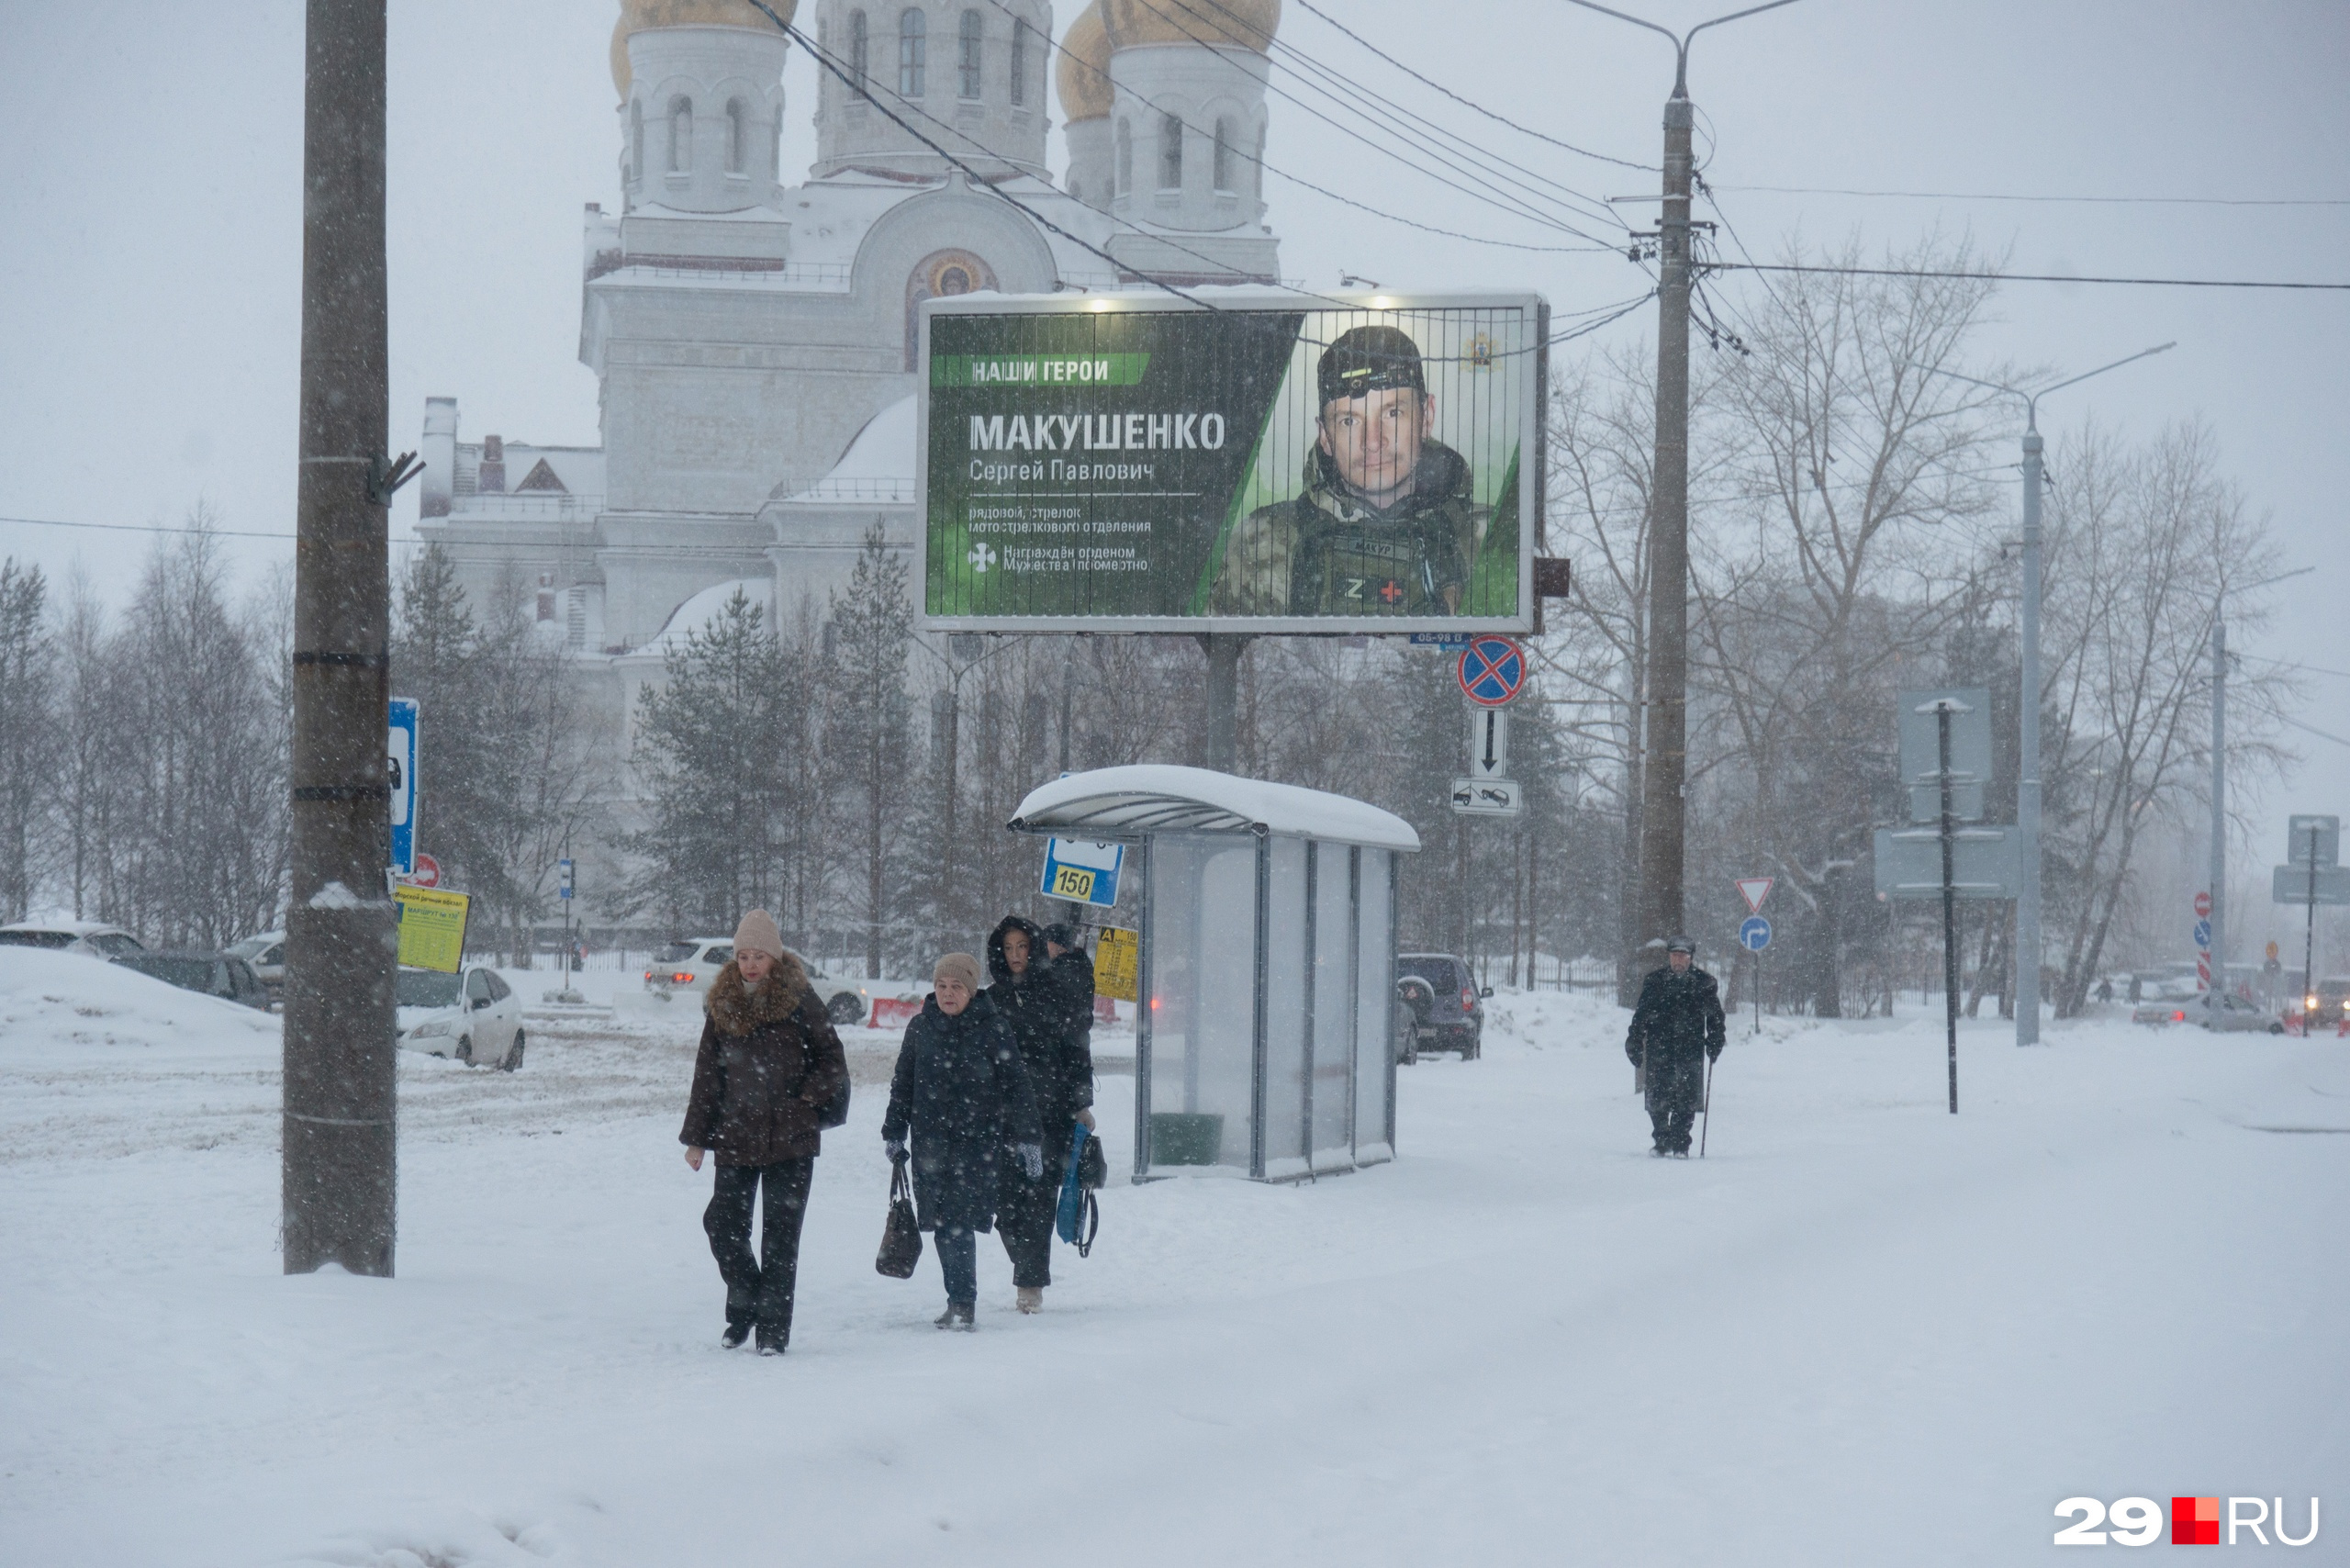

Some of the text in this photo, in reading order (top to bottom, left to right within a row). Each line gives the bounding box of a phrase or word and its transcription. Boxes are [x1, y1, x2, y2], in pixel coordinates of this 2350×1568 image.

[972, 361, 1108, 382] НАШИ ГЕРОИ
[969, 413, 1225, 451] МАКУШЕНКО
[970, 459, 1155, 485] Сергей Павлович
[968, 506, 1081, 521] рядовой, стрелок
[968, 521, 1152, 535] мотострелкового отделения
[1003, 544, 1136, 561] Награждён орденом
[1003, 558, 1069, 574] Мужества
[1345, 578, 1366, 598] Z
[1418, 633, 1451, 643] 05-98
[1058, 869, 1091, 897] 150
[408, 906, 439, 916] МАРШРУТ
